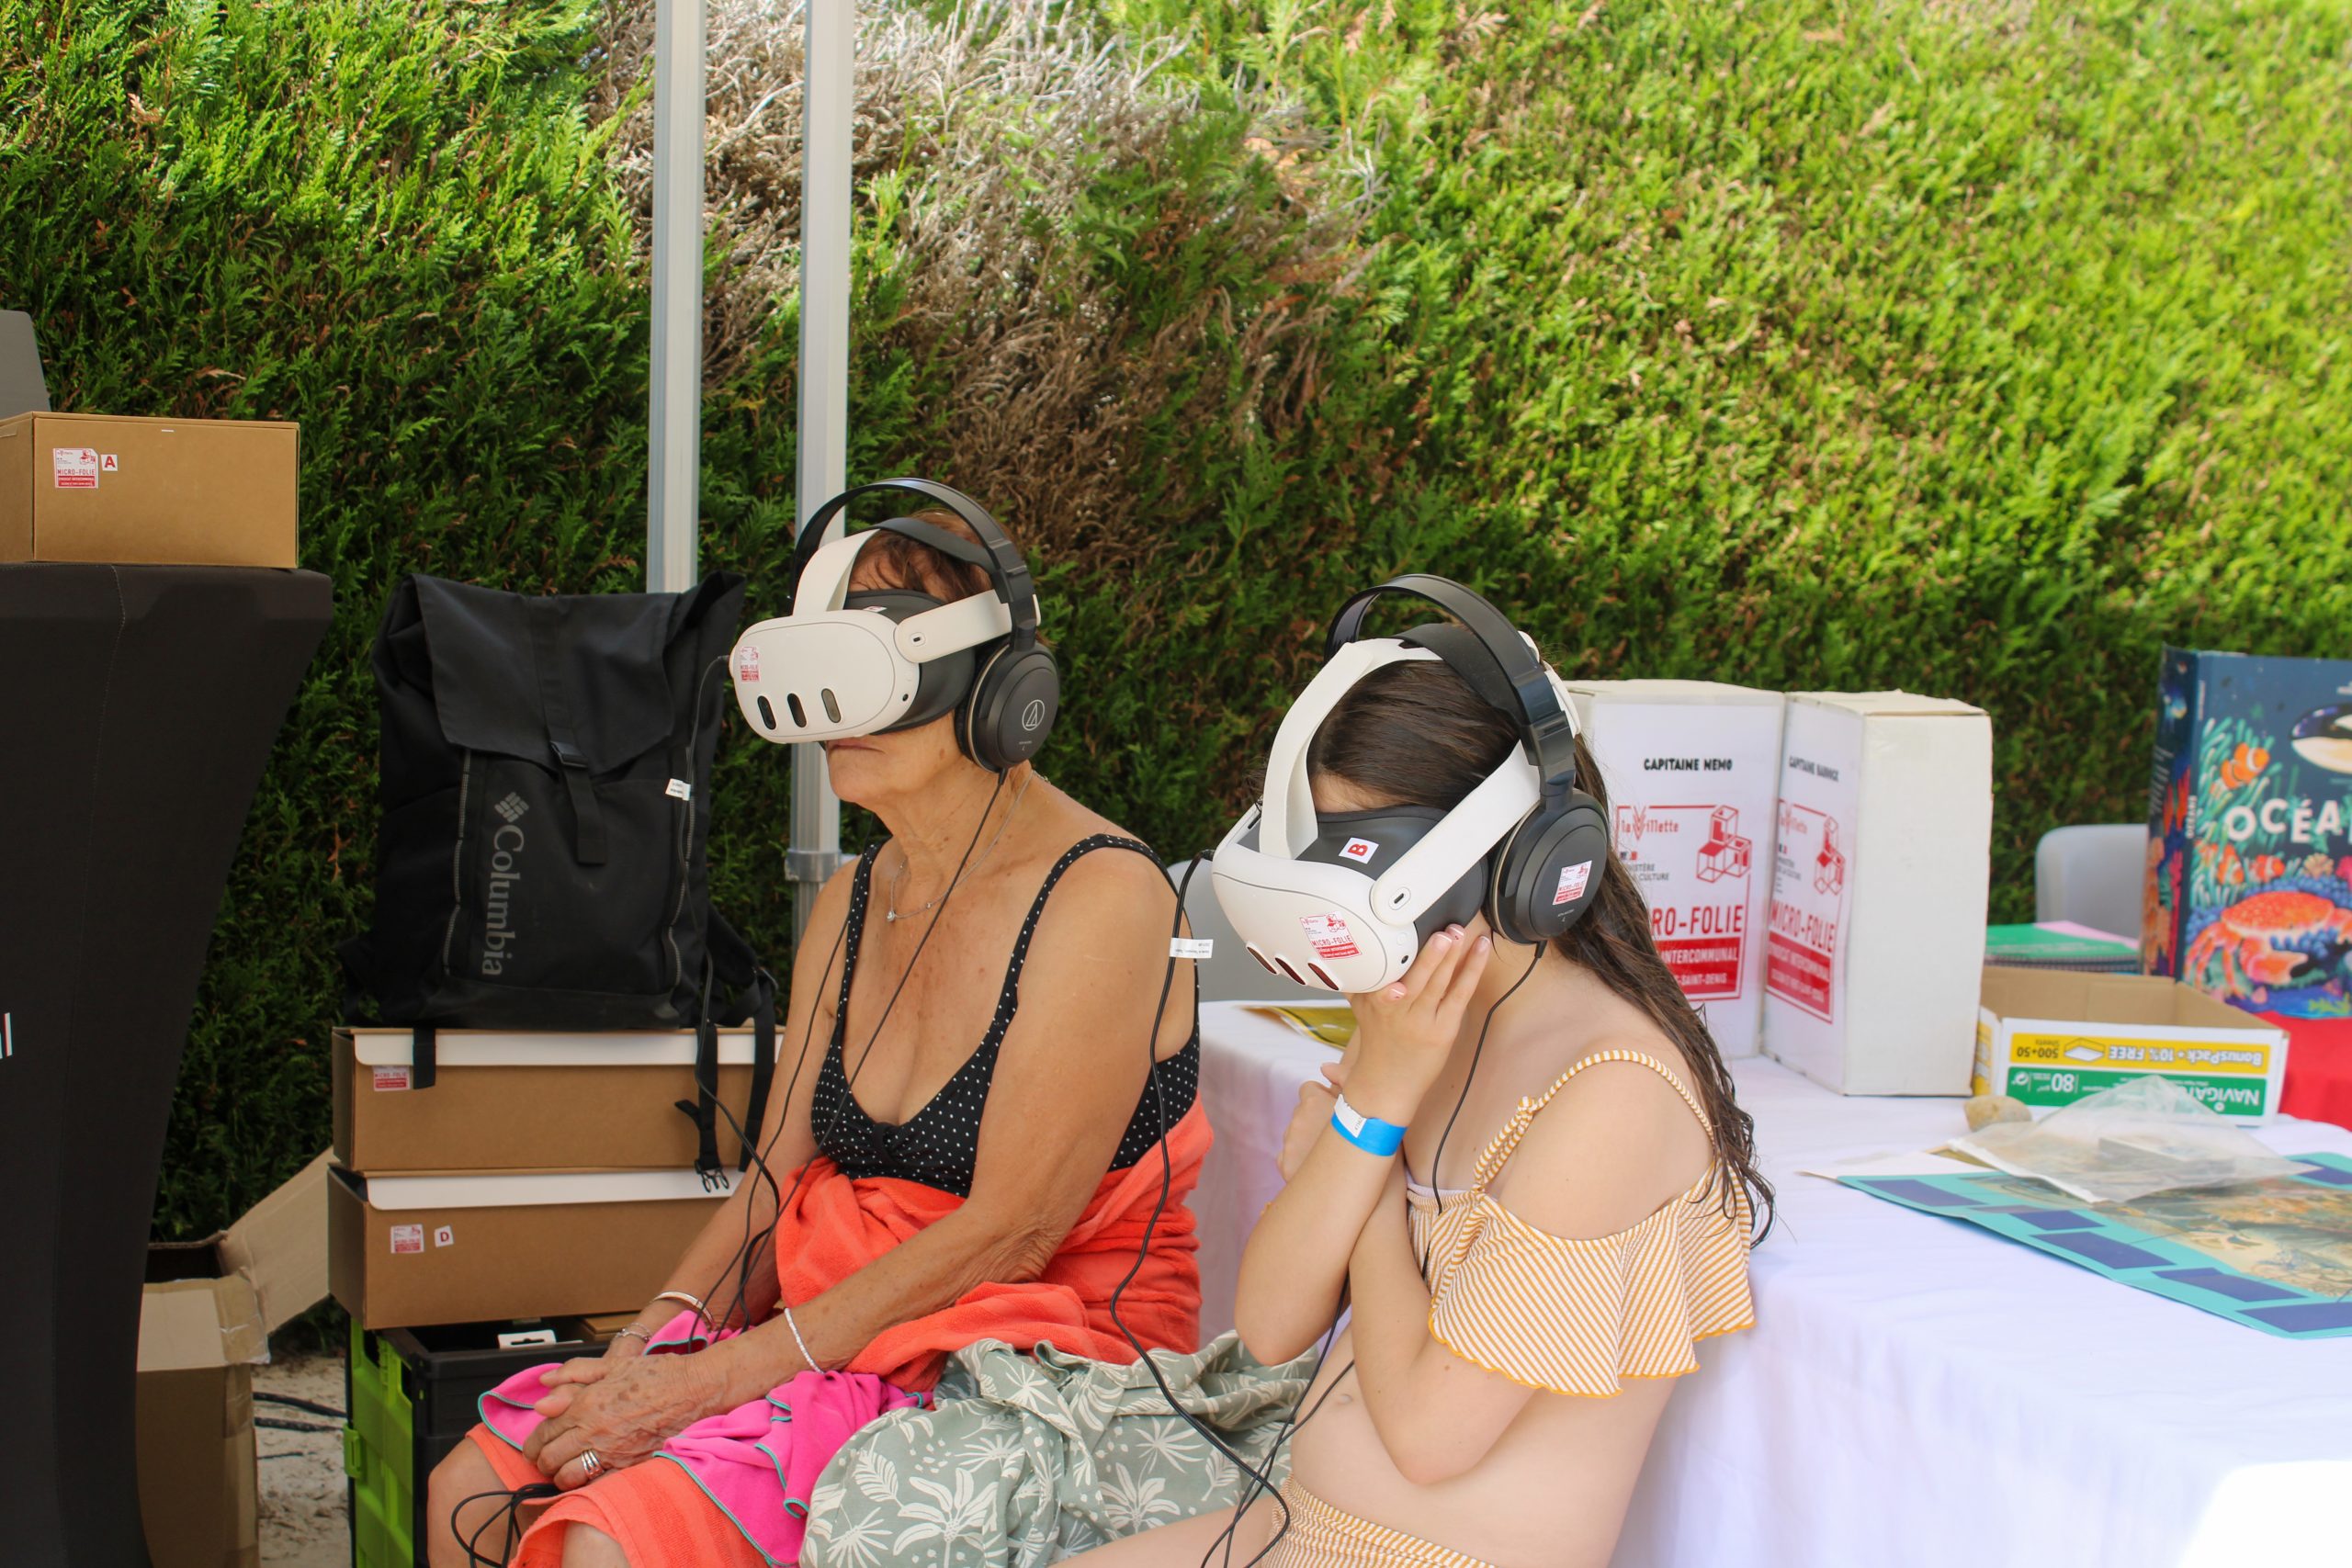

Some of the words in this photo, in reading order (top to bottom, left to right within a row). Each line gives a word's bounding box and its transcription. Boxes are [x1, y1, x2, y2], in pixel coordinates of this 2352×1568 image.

[104, 456, 116, 468] A
[1644, 758, 1700, 771] CAPITAINE
[1703, 759, 1733, 771] NEMO
[2224, 797, 2352, 845] OCÉA
[1347, 843, 1368, 856] B
[481, 824, 525, 976] Columbia
[1651, 904, 1744, 936] RO-FOLIE
[1772, 899, 1837, 953] MICRO-FOLIE
[1310, 934, 1351, 947] MICRO-FOLIE
[2109, 1045, 2145, 1061] FREE
[2148, 1047, 2176, 1062] 10%
[2187, 1049, 2264, 1067] BonusPack
[2051, 1073, 2075, 1092] 80
[440, 1231, 449, 1242] D
